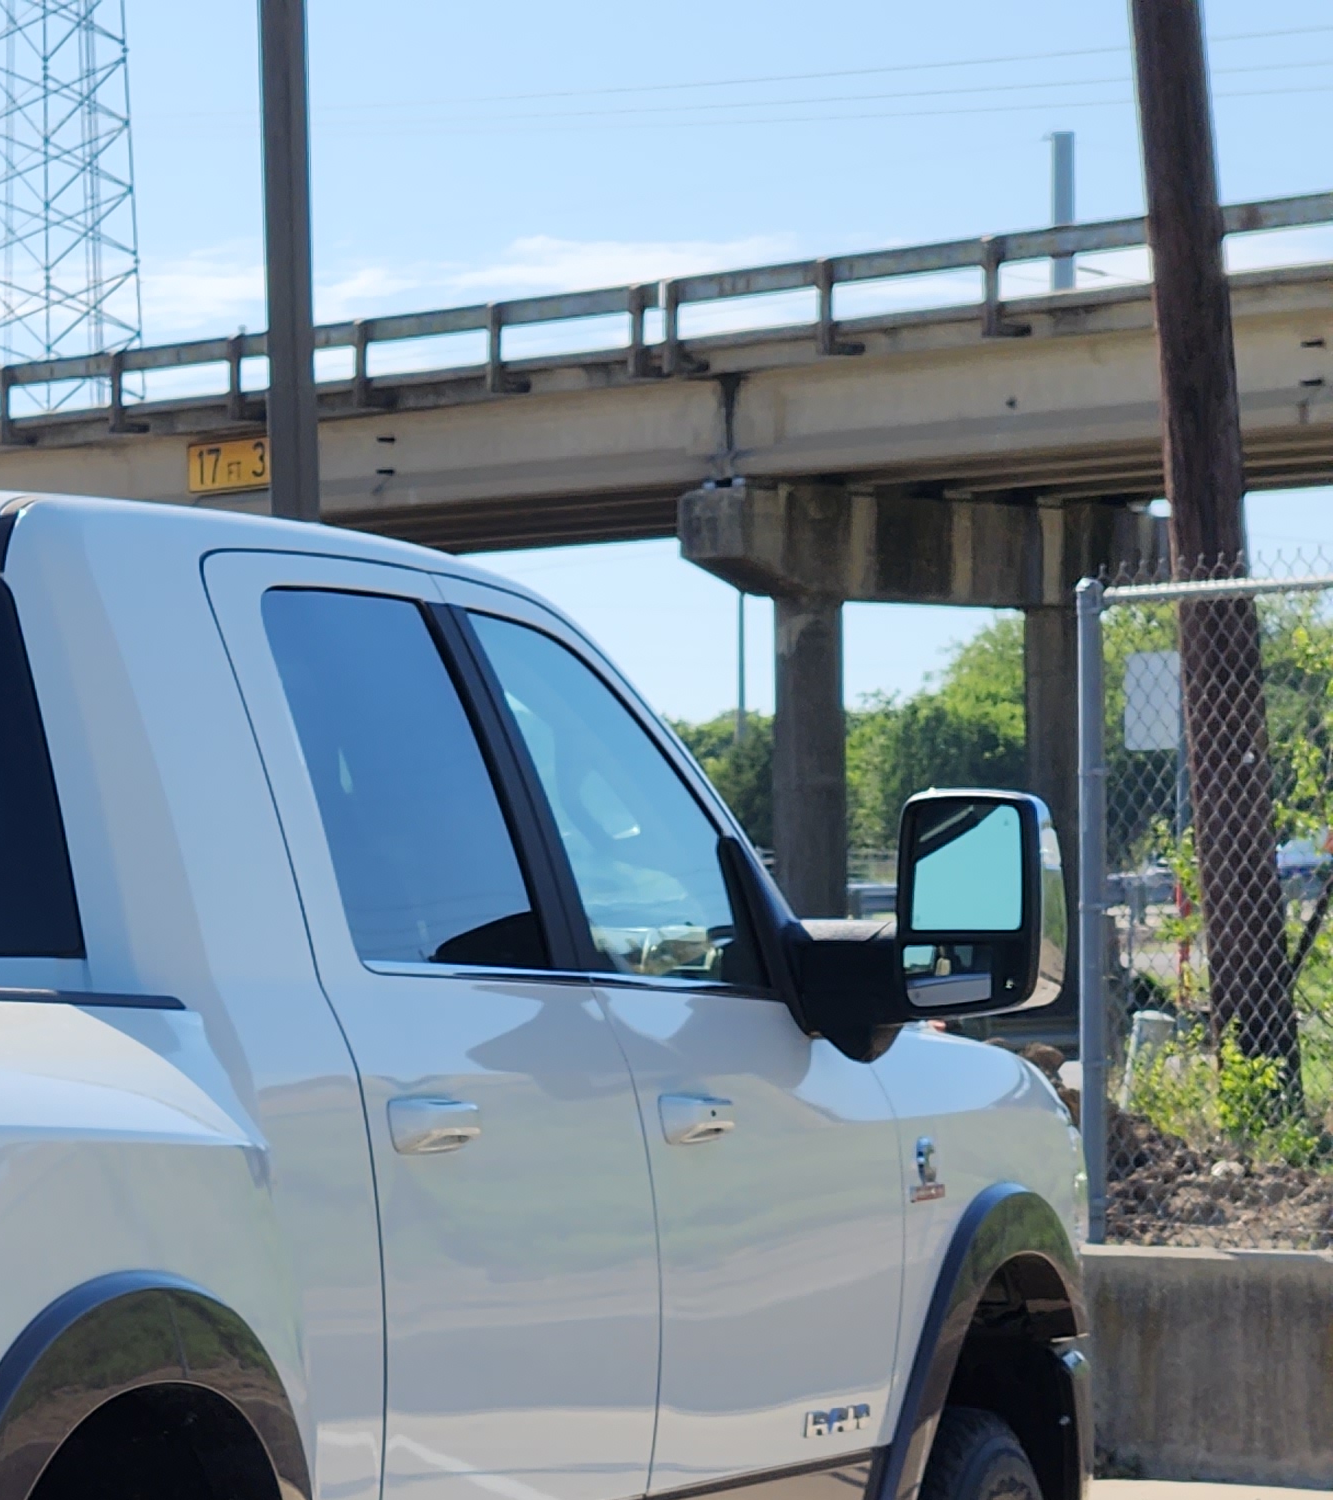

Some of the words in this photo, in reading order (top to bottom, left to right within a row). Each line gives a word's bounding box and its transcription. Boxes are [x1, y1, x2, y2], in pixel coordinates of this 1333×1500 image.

[197, 447, 222, 485] 17
[227, 461, 242, 481] FT
[251, 441, 266, 477] 3
